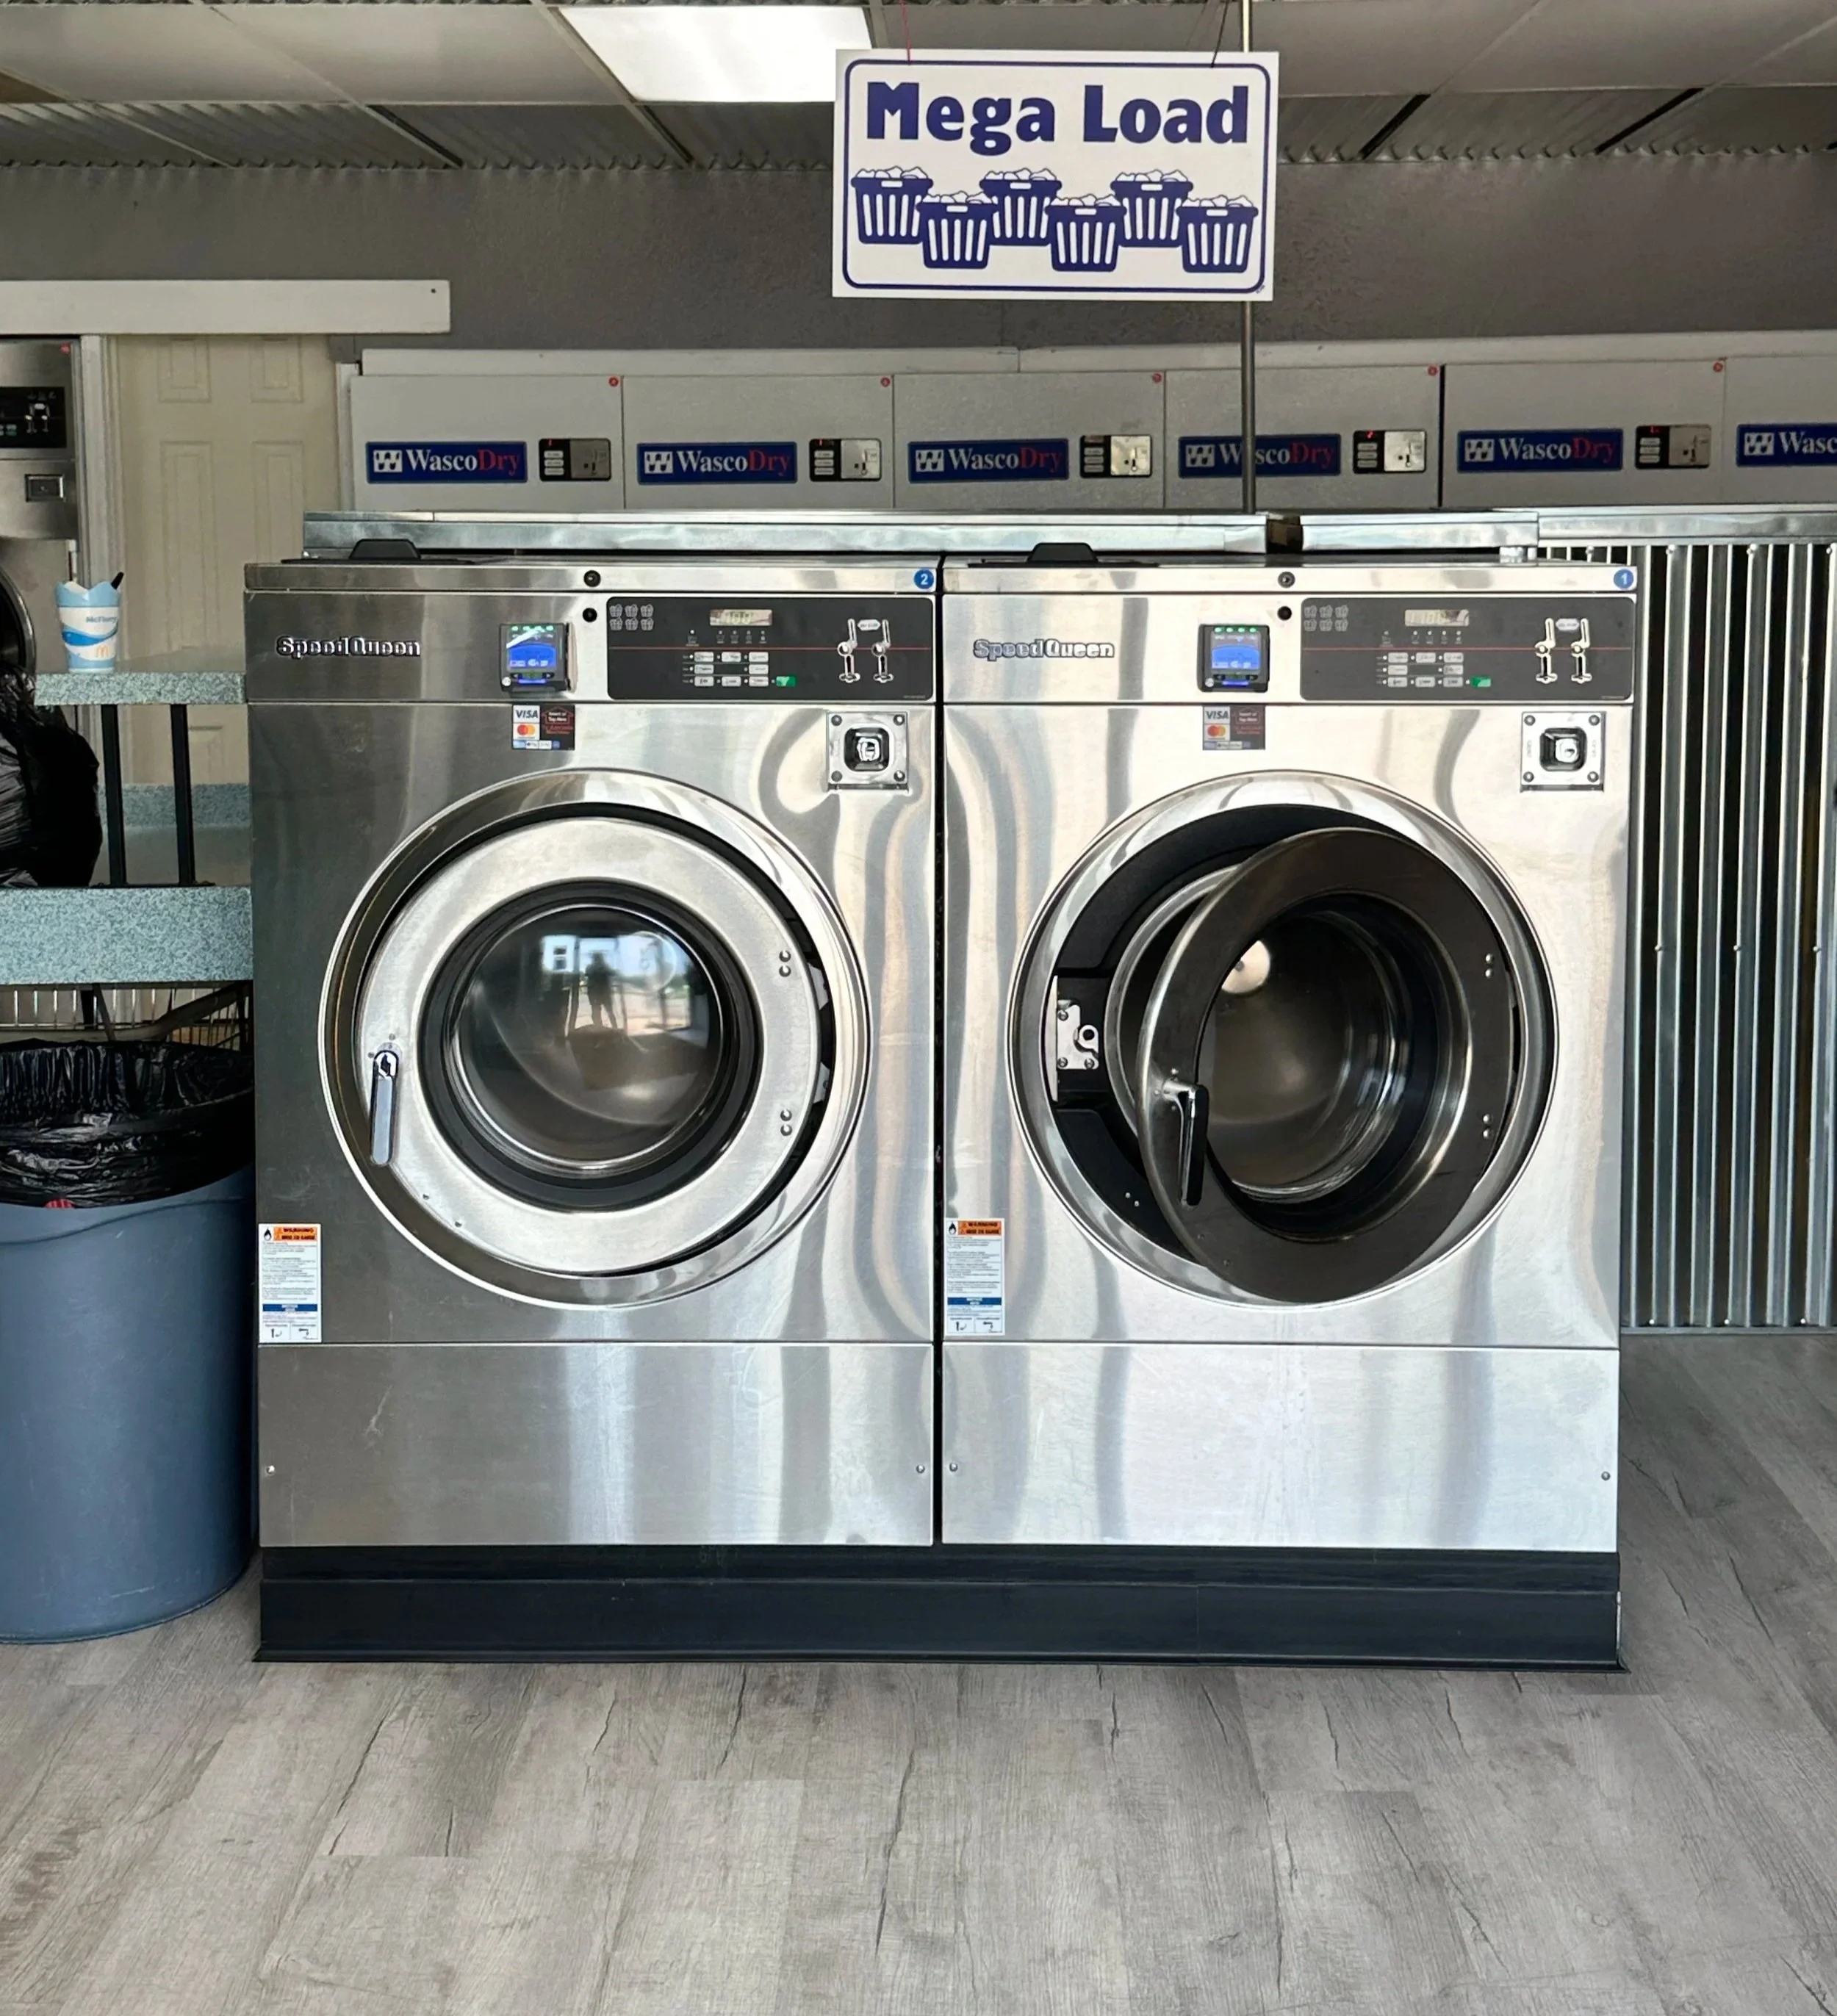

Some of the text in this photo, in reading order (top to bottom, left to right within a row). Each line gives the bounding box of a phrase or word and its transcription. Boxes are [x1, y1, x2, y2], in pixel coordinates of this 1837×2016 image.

[867, 82, 1248, 156] Mega Load
[406, 449, 519, 476] WascoDry
[676, 449, 790, 477] WascoDry
[948, 447, 1062, 473] WascoDry
[1219, 442, 1332, 469] WscoDry
[1499, 437, 1613, 464] WascoDry
[921, 573, 928, 586] 2
[1621, 572, 1628, 585] 1
[516, 710, 538, 719] VISA
[1206, 710, 1229, 719] VISA
